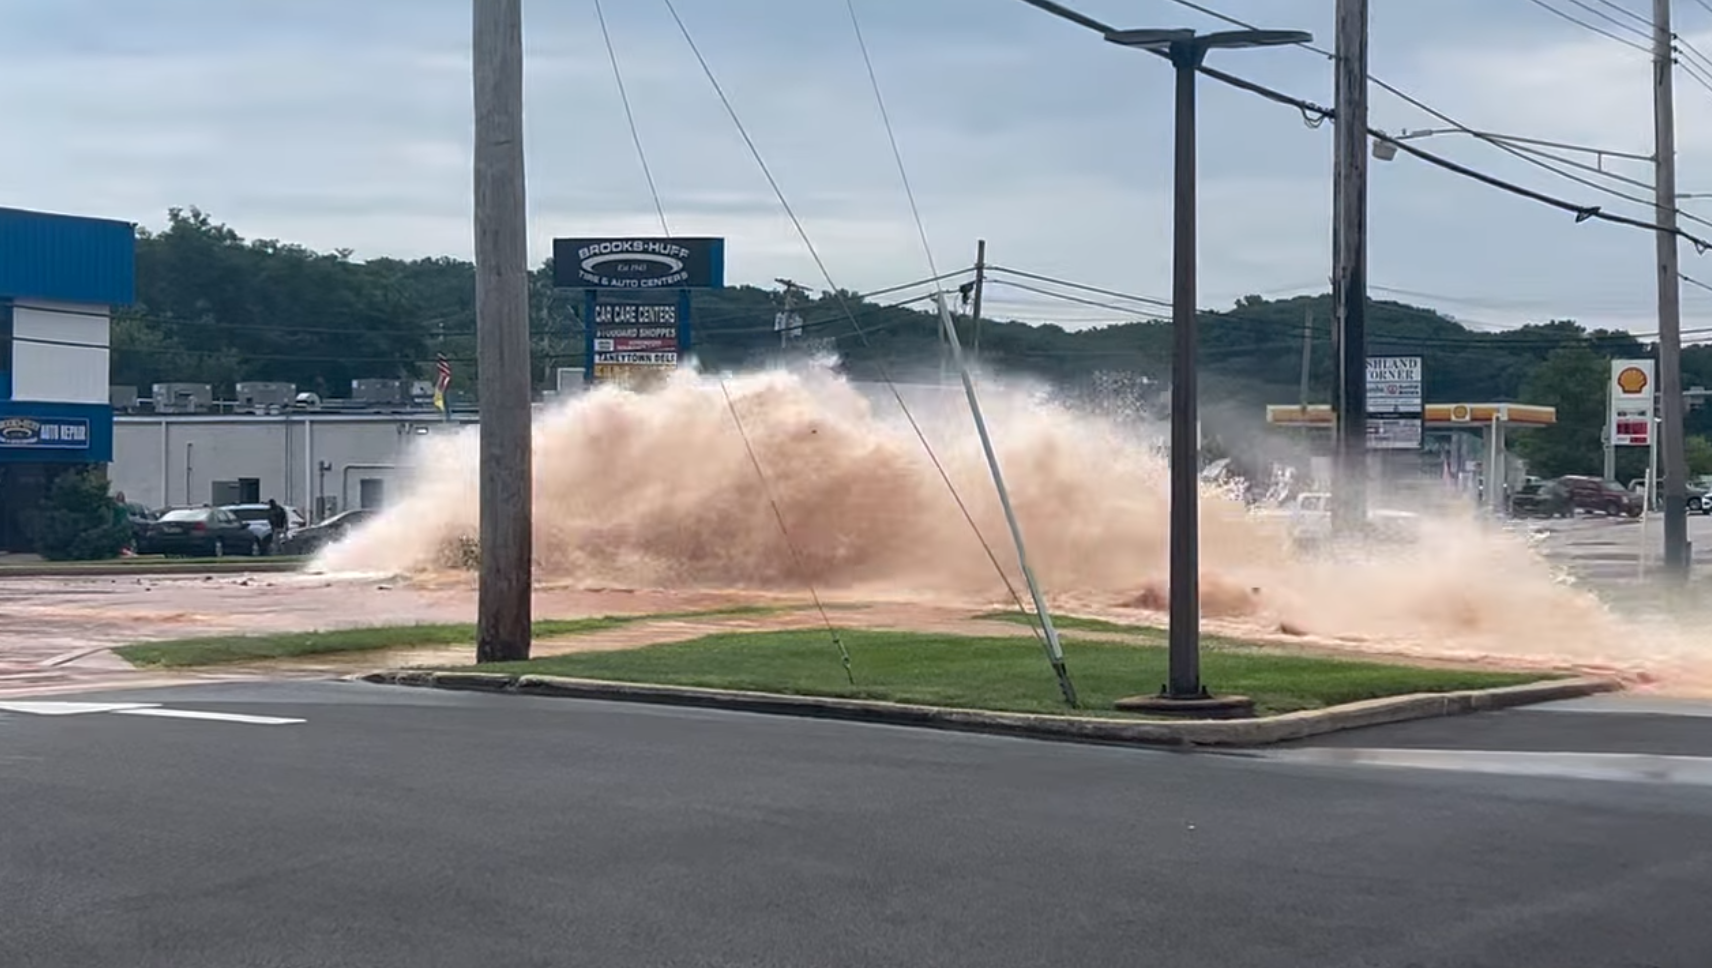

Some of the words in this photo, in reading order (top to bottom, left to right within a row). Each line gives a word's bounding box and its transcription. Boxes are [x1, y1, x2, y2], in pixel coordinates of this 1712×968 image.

[579, 270, 599, 283] TIRE
[601, 277, 609, 285] &
[611, 279, 638, 287] AUTO
[641, 271, 688, 287] CENTERS
[595, 306, 612, 323] CAR
[613, 306, 636, 323] CARE
[638, 306, 675, 323] CENTERS
[1365, 359, 1417, 369] SHLAND
[1368, 369, 1414, 380] ORNER
[40, 424, 59, 440] AUTO
[60, 425, 86, 440] REPAIR
